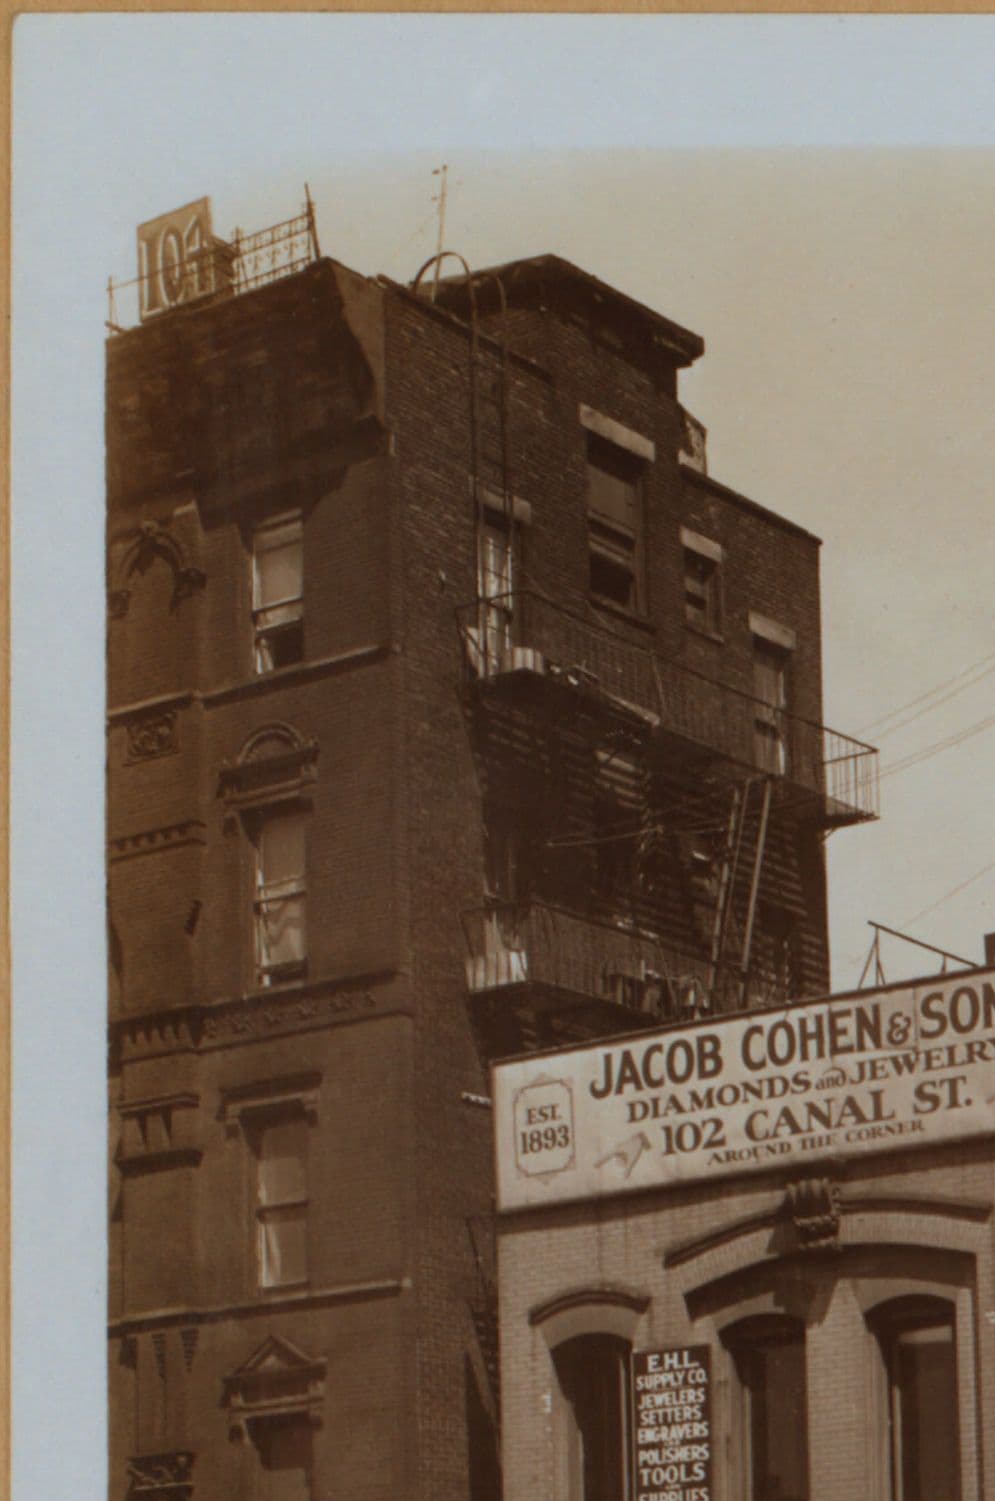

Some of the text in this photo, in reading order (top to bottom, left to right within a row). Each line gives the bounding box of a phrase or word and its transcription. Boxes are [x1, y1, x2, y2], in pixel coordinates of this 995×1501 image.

[589, 1033, 723, 1100] JACOB
[741, 1003, 882, 1071] COHEN
[886, 1011, 912, 1046] &
[627, 1071, 812, 1123] DIAMONDS
[815, 1066, 847, 1091] and
[662, 1075, 973, 1156] 102 CANAL ST.
[521, 1124, 570, 1154] 1893
[708, 1119, 925, 1166] AROUND THE CORNER
[636, 1370, 685, 1391] SUPPLY
[638, 1387, 705, 1410] JEWELERS
[640, 1404, 702, 1426] SETTERS
[638, 1421, 709, 1444] ENGRAVERS
[639, 1443, 710, 1467] POLISHERS
[640, 1463, 705, 1487] TOOLS
